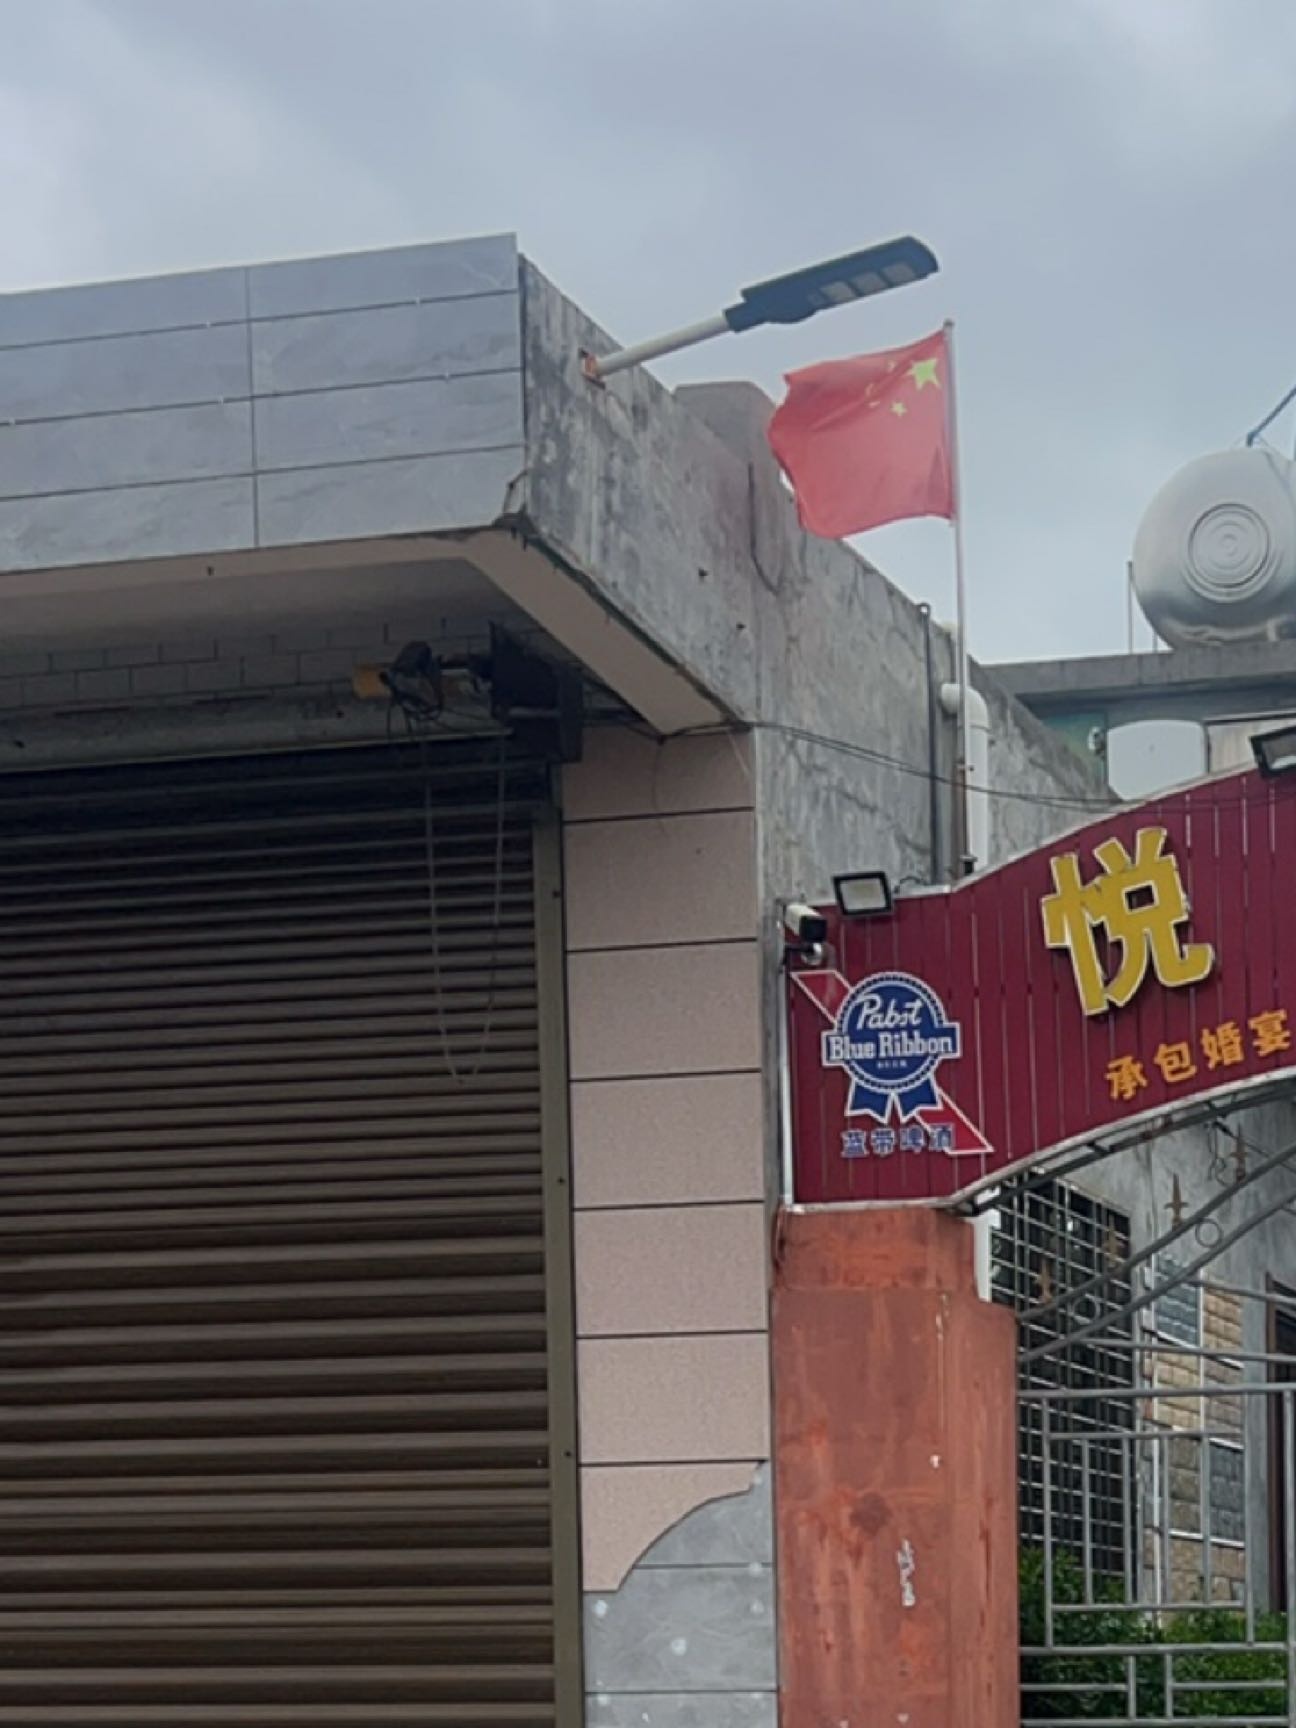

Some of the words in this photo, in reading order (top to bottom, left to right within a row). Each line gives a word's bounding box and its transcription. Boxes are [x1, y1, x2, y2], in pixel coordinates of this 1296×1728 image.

[856, 992, 923, 1030] Pabst
[829, 1034, 876, 1060] Blue
[878, 1030, 953, 1058] Ribbon
[1105, 1008, 1292, 1101] 承包婚宴
[841, 1123, 955, 1158] 蓝带啤酒
